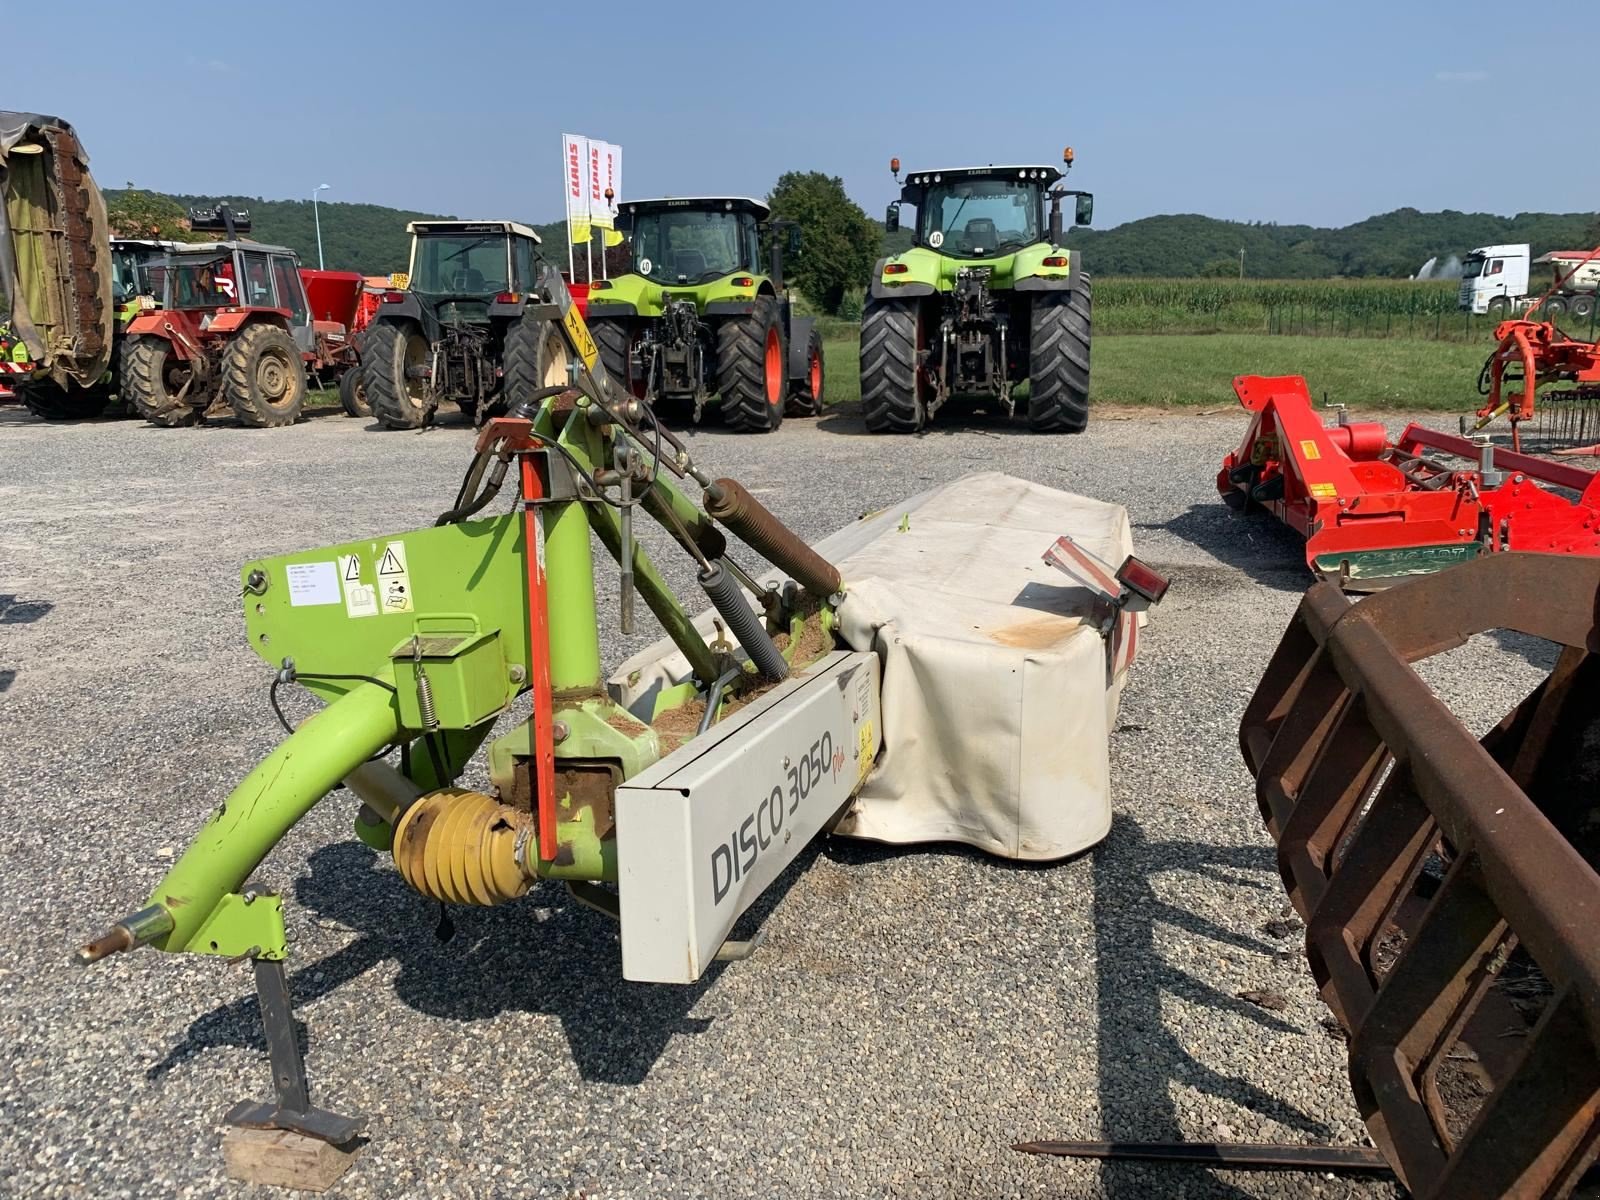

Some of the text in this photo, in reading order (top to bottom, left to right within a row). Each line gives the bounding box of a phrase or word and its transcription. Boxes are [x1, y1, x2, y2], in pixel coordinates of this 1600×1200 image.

[569, 143, 580, 197] CLAAS
[592, 148, 602, 201] CLAAS
[932, 234, 941, 245] 40
[642, 261, 650, 272] 40
[711, 785, 784, 906] DISCO
[787, 731, 832, 816] 3050
